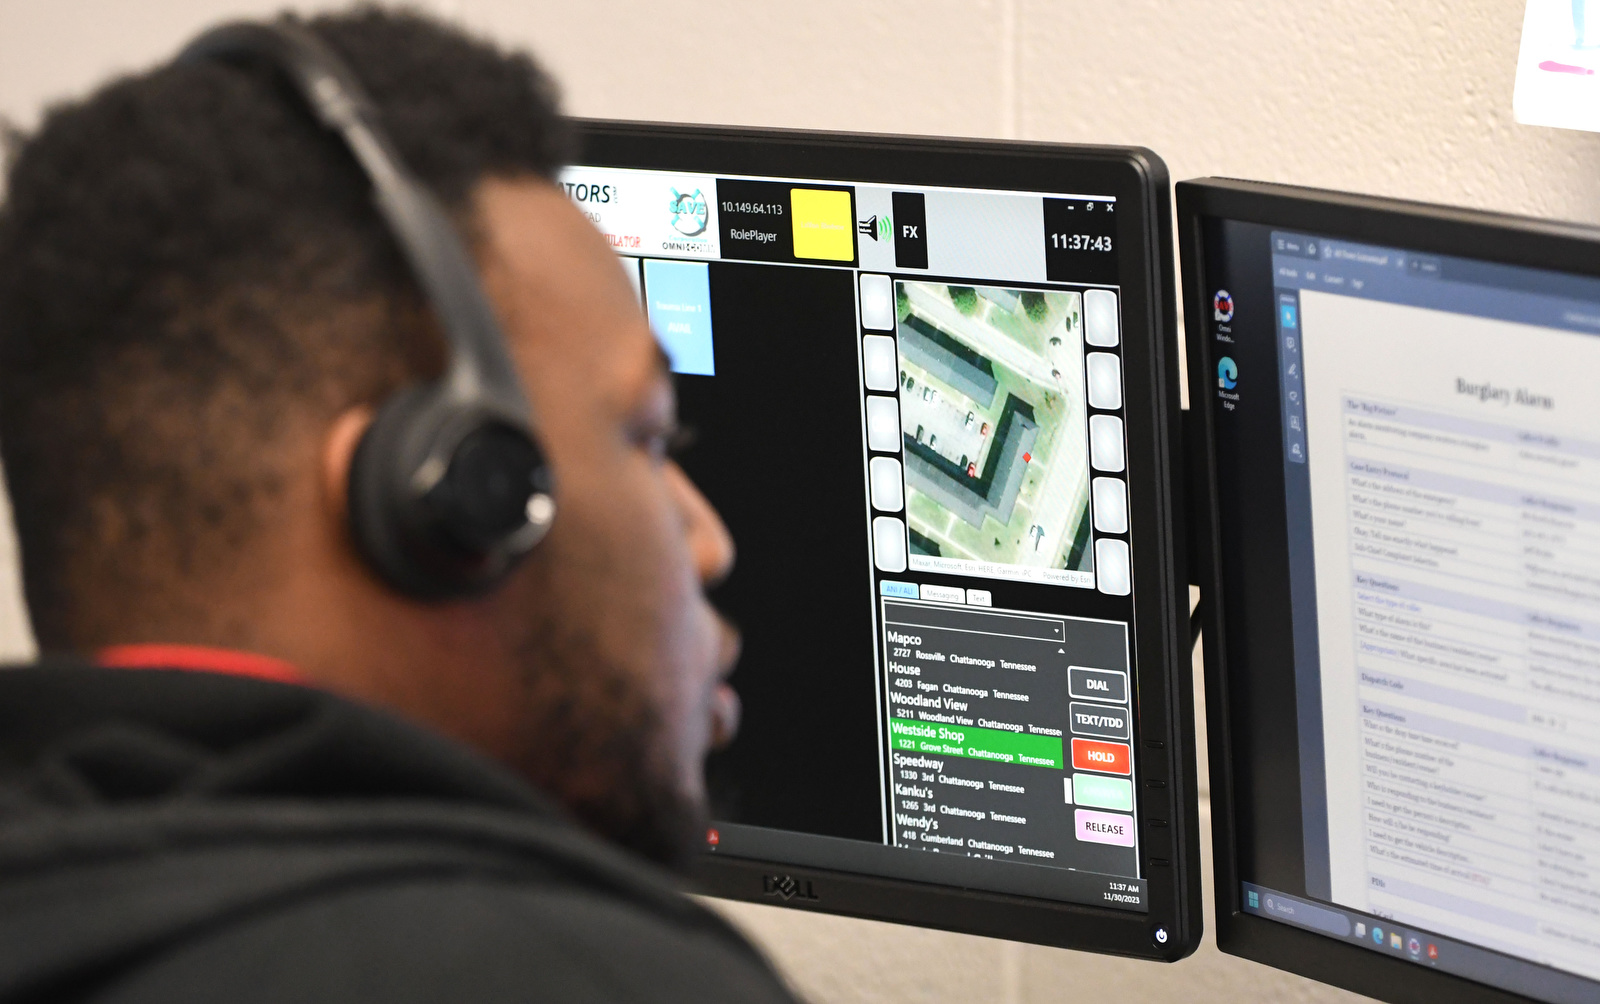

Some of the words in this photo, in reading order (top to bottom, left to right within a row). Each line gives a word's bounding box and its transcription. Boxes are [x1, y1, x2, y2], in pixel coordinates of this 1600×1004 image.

[669, 200, 706, 215] SAVE
[721, 201, 783, 215] 10.149.64.113
[730, 228, 777, 244] RolePlayer
[902, 225, 918, 239] FX
[604, 234, 641, 248] ULATOR
[1051, 233, 1112, 251] 11:37:43
[1218, 324, 1232, 332] Omni
[1218, 390, 1240, 400] Microsoft
[1456, 377, 1510, 407] Burglary
[1516, 386, 1555, 410] Alarm
[1224, 400, 1235, 411] Edge
[1043, 571, 1069, 581] Powered
[1070, 574, 1078, 584] by
[1080, 574, 1092, 584] Esri
[886, 585, 898, 593] ANI
[903, 587, 914, 595] ALI
[926, 590, 959, 602] Messaging
[973, 594, 985, 602] Text
[888, 631, 922, 646] Mapco
[894, 648, 910, 658] 2727
[916, 650, 946, 662] Rossville
[950, 654, 996, 669] Chattanooga
[1000, 659, 1036, 672] Tennessee
[889, 661, 920, 676] House
[895, 678, 912, 689] 4203
[917, 681, 938, 693] Fagan
[943, 684, 988, 699] Chattanooga
[992, 690, 1029, 702] Tennessee
[1086, 678, 1110, 692] DIAL
[890, 692, 942, 709] Woodland
[944, 698, 968, 712] View
[896, 708, 914, 719] 5211
[918, 710, 954, 723] Woodland
[956, 715, 973, 726] View
[978, 718, 1023, 733] Chattanooga
[1075, 713, 1124, 728] TEXT/TDD
[892, 722, 936, 738] Westside
[938, 728, 964, 744] Shop
[898, 739, 916, 750] 1221
[920, 742, 942, 753] Grove
[942, 744, 964, 756] Street
[968, 747, 1014, 763] Chattanooga
[1018, 754, 1054, 766] Tennessee
[1088, 750, 1115, 764] HOLD
[894, 753, 944, 772] Speedway
[900, 770, 918, 780] 1330
[922, 772, 934, 784] 3rd
[938, 774, 984, 790] Chattanooga
[988, 781, 1025, 794] Tennessee
[895, 783, 934, 799] Kanku's
[902, 800, 919, 812] 1265
[924, 803, 936, 814] 3rd
[940, 804, 986, 820] Chattanooga
[990, 812, 1026, 825] Tennessee
[896, 813, 938, 832] Wendy's
[1086, 822, 1124, 836] RELEASE
[902, 830, 916, 840] 418
[920, 832, 964, 846] Cumberland
[968, 838, 1014, 854] Chattanooga
[1018, 846, 1054, 859] Tennessee
[763, 875, 819, 900] DELL
[1109, 882, 1126, 892] 11:37
[1128, 884, 1139, 893] AM
[1104, 892, 1140, 904] 11/30/2023
